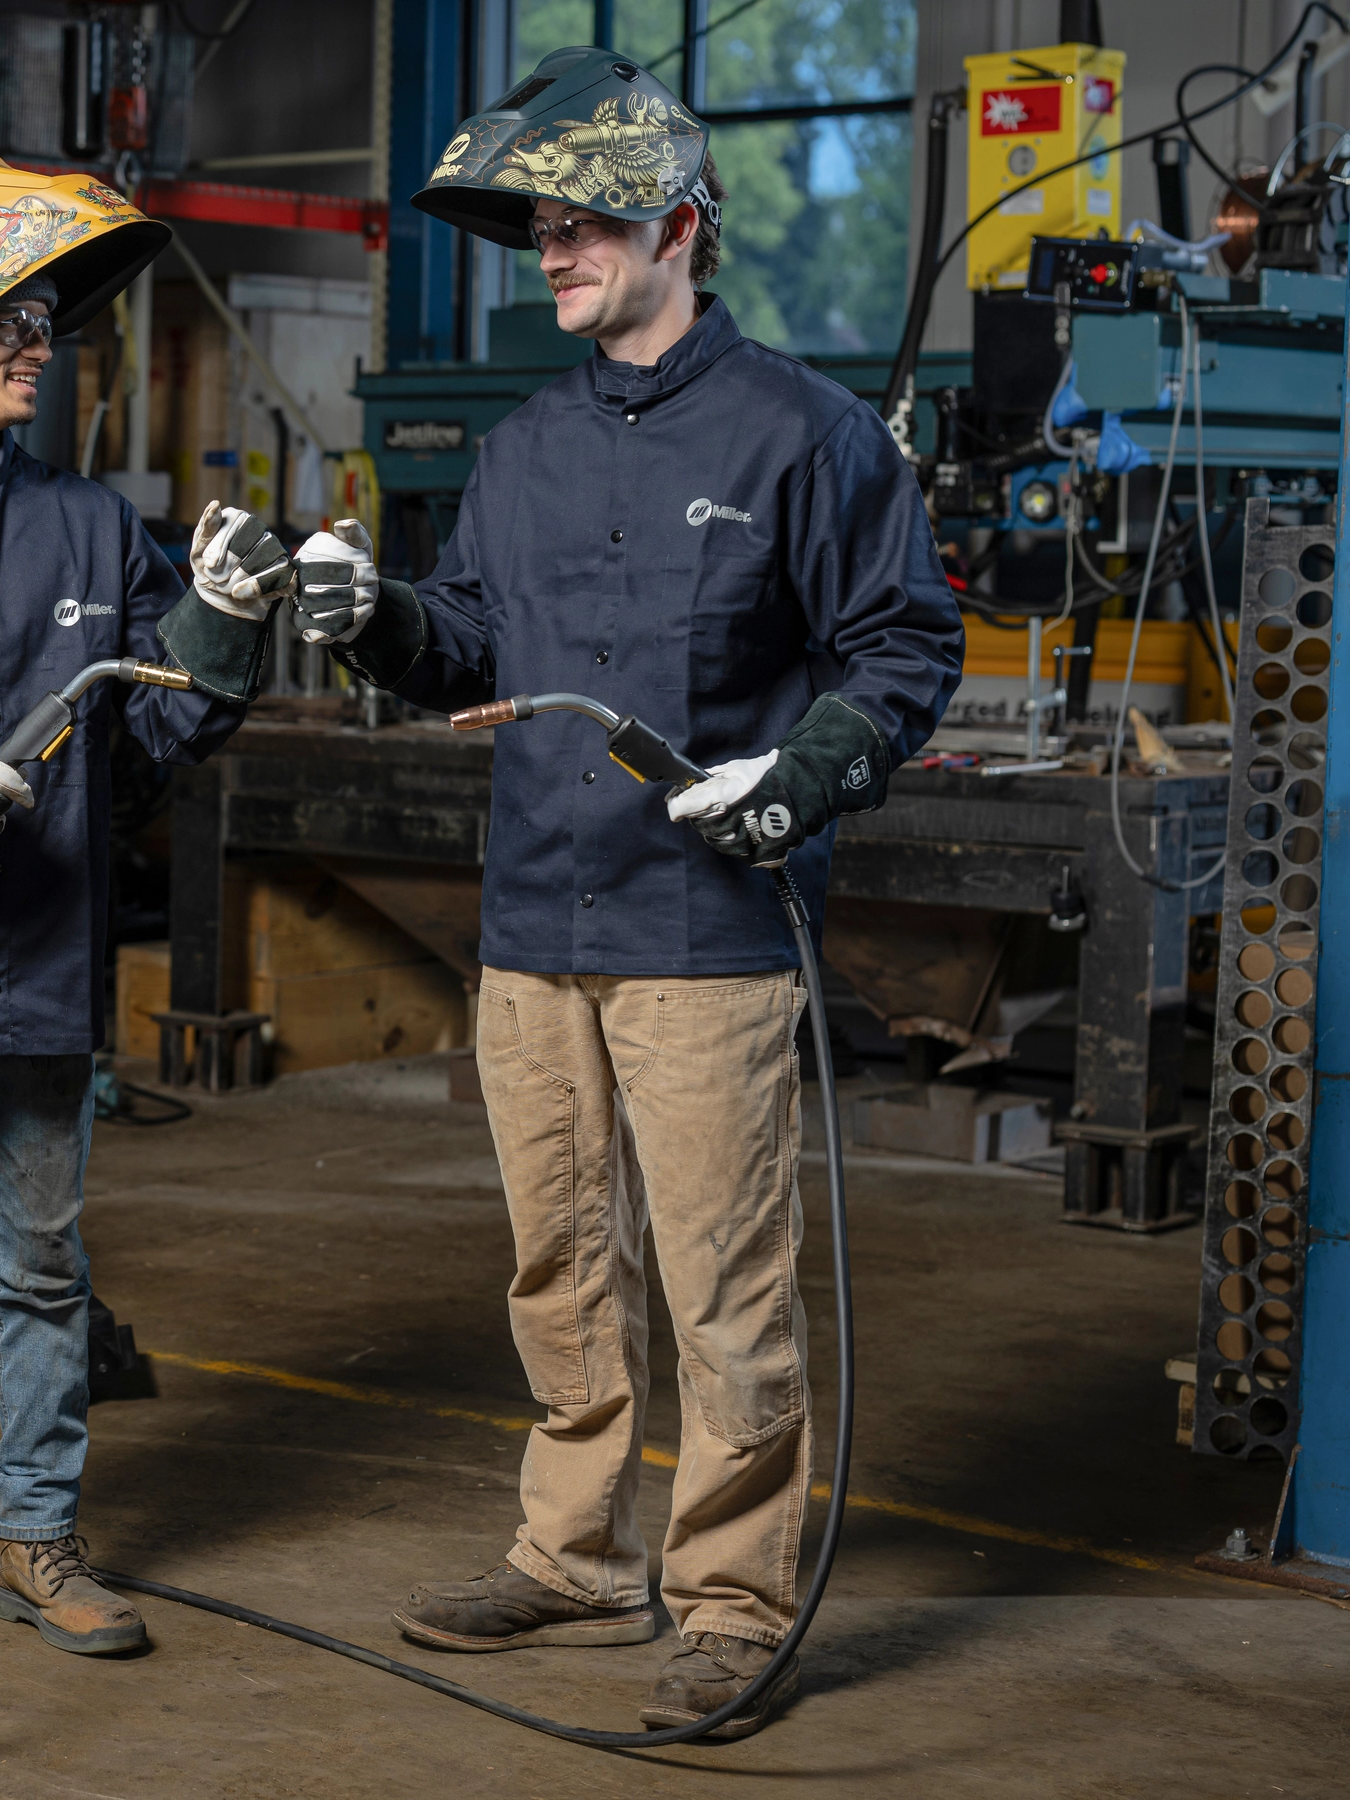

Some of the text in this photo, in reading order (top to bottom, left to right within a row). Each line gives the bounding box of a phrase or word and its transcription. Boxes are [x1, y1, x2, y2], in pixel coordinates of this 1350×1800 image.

[430, 163, 463, 182] Miller
[712, 504, 752, 523] Miller
[81, 603, 116, 616] Miller
[850, 769, 863, 786] A5
[742, 809, 763, 845] Miller
